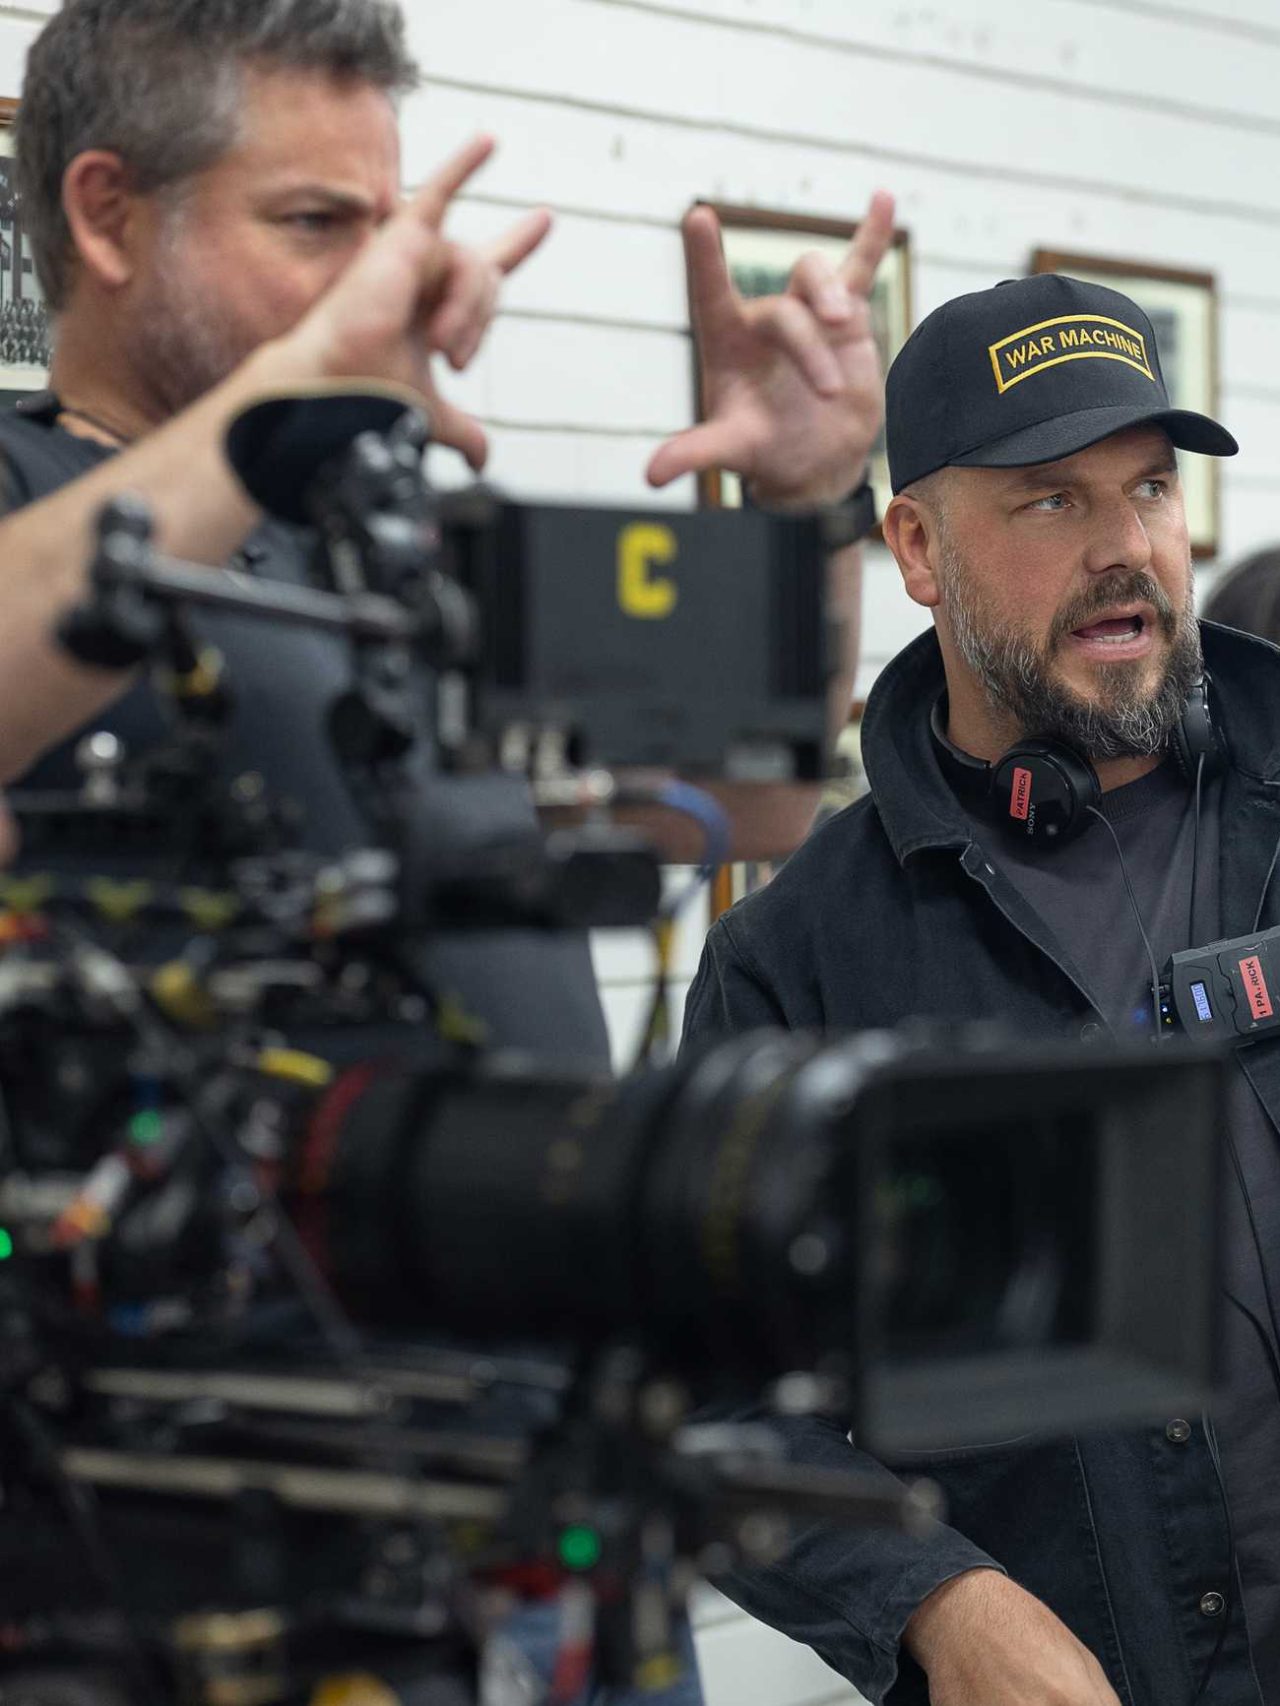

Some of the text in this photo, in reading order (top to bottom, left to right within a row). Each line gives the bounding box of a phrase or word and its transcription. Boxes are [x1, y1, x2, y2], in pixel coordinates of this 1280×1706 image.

[1004, 328, 1143, 369] WAR MACHINE
[617, 521, 678, 620] C
[1016, 772, 1028, 816] PATRICK
[1246, 960, 1266, 1008] PARICK
